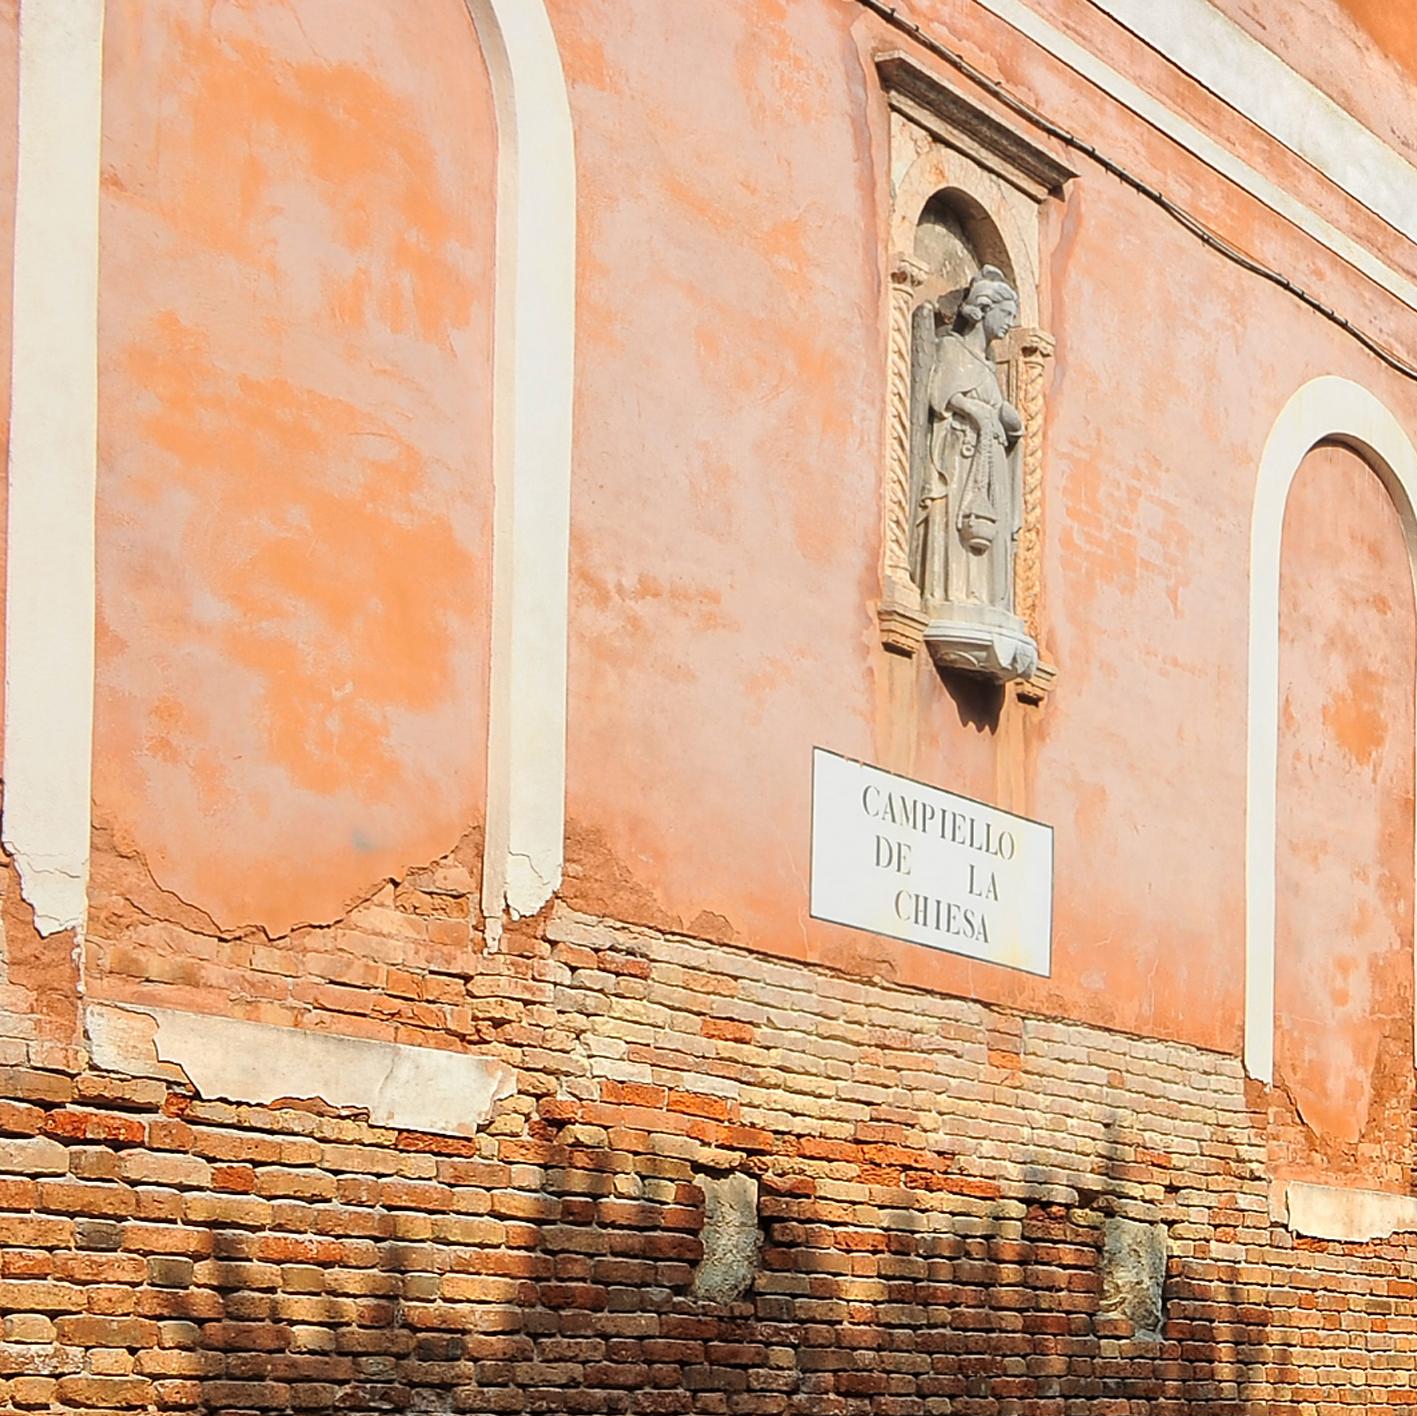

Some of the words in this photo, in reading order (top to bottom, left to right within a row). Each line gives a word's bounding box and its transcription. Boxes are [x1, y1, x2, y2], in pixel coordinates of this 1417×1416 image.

[862, 784, 1015, 861] CAMPIELLO
[875, 834, 912, 876] DE
[968, 863, 999, 902] LA
[894, 889, 990, 944] CHIESA
